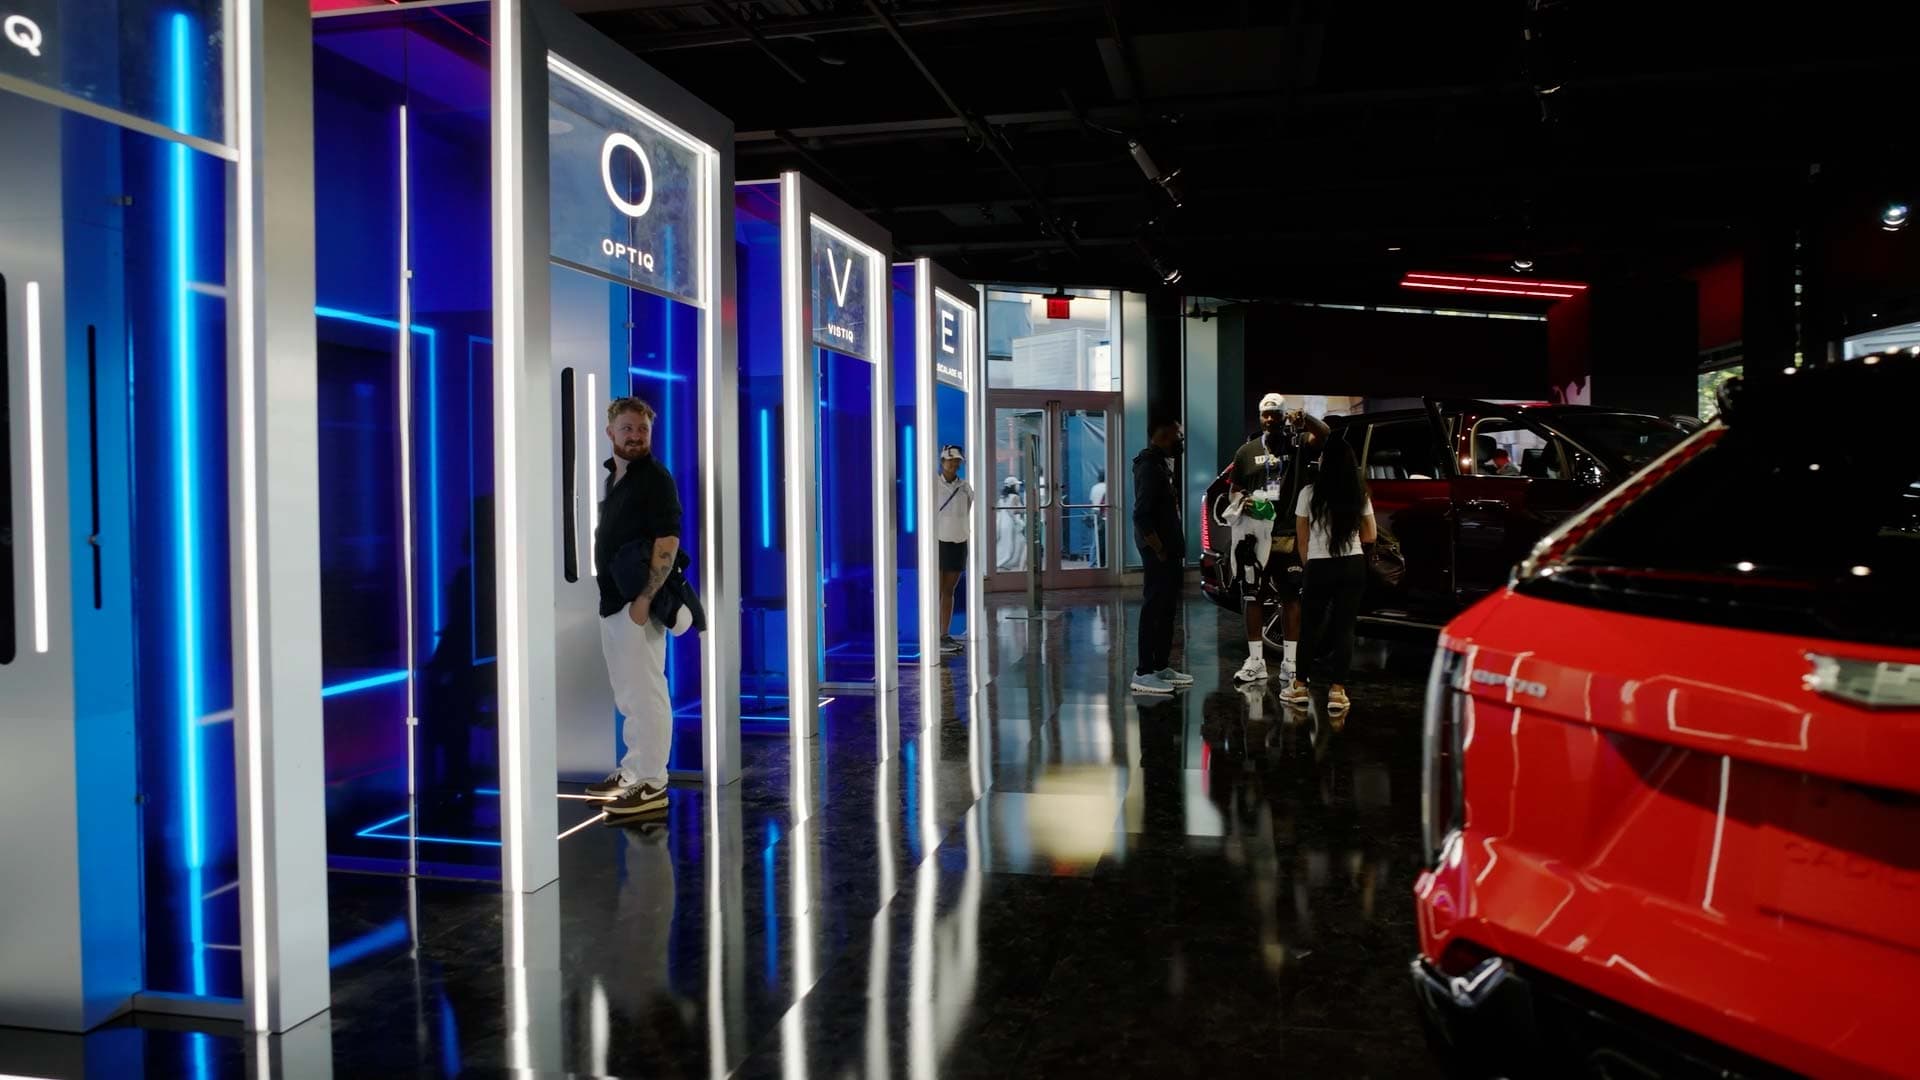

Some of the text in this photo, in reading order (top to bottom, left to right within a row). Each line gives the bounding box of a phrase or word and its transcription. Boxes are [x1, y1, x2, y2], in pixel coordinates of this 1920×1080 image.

[602, 132, 653, 217] O
[602, 238, 655, 273] OPTIQ
[827, 247, 853, 308] V
[828, 323, 854, 343] VISTIQ
[942, 309, 954, 354] E
[936, 362, 957, 378] SCALADE
